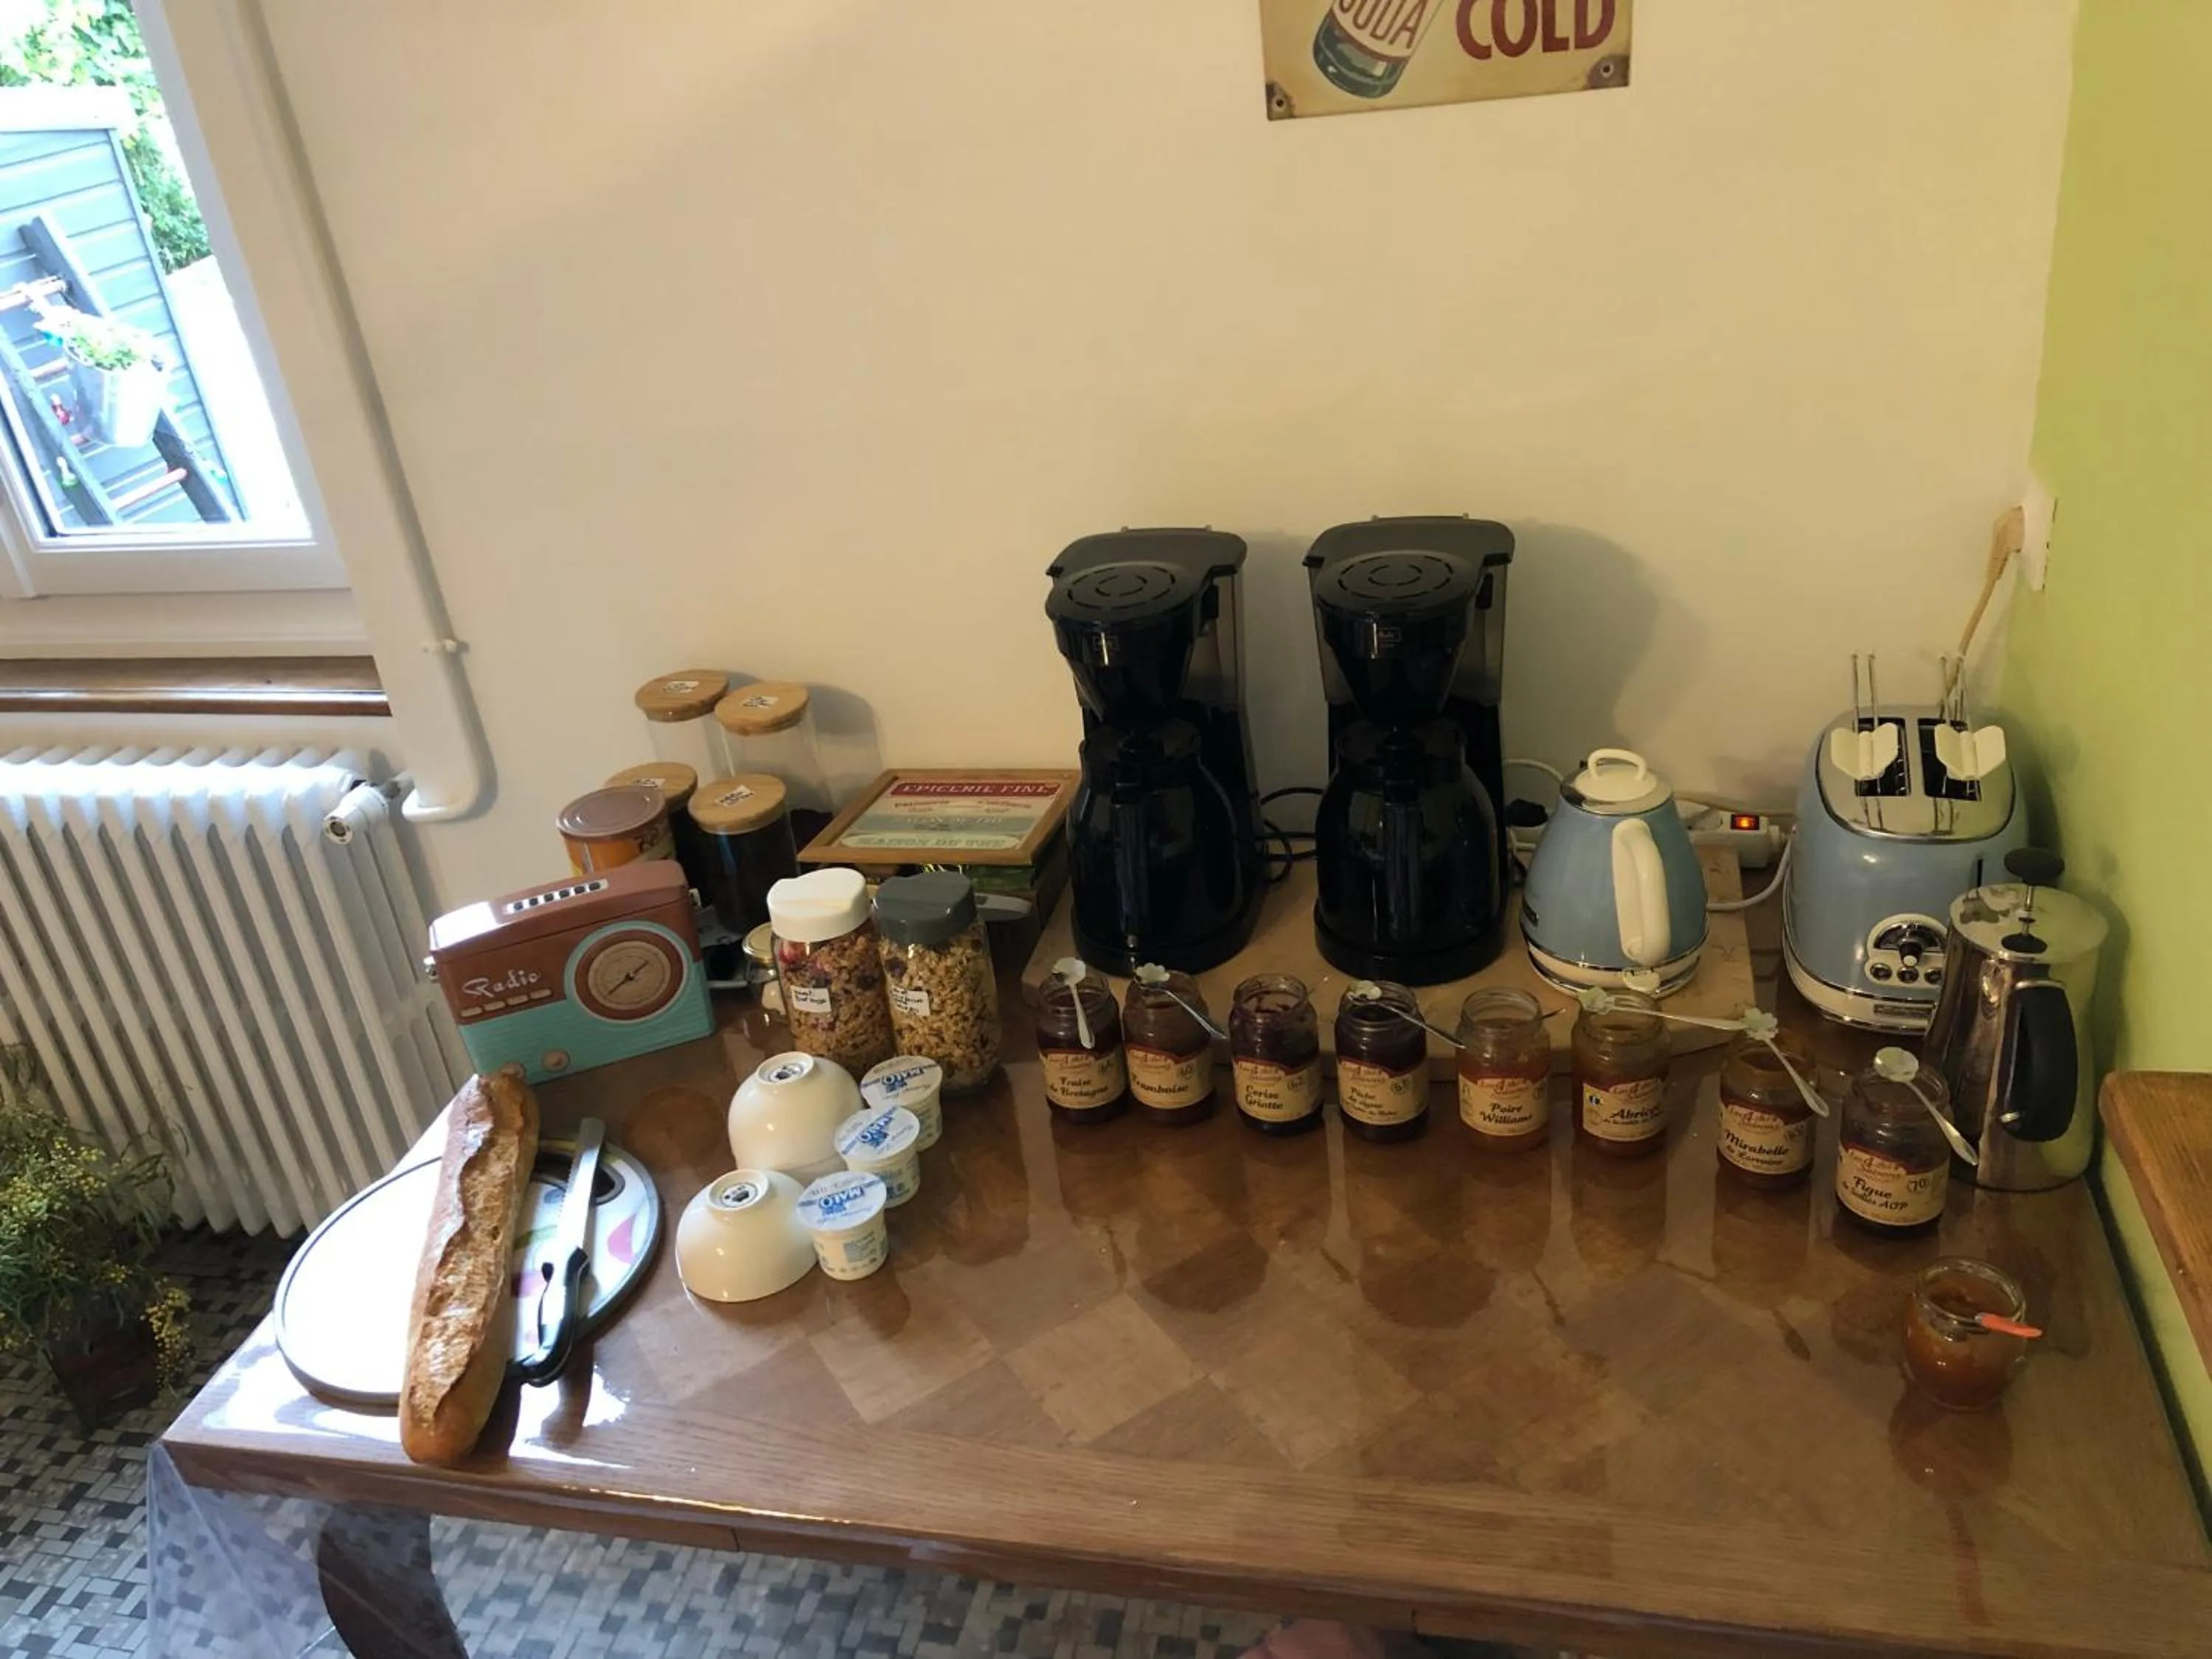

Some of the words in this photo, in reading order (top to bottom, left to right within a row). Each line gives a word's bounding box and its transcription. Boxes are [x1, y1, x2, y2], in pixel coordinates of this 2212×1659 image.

[1339, 0, 1425, 49] ODA
[1455, 0, 1615, 60] COLD
[462, 968, 541, 998] Radio
[1245, 1085, 1279, 1099] Cerise
[1480, 1110, 1533, 1124] Williams
[1489, 1102, 1523, 1113] Poire
[1725, 1128, 1790, 1155] Mirabelle
[819, 1186, 863, 1208] MALO
[1852, 1175, 1893, 1199] Figue
